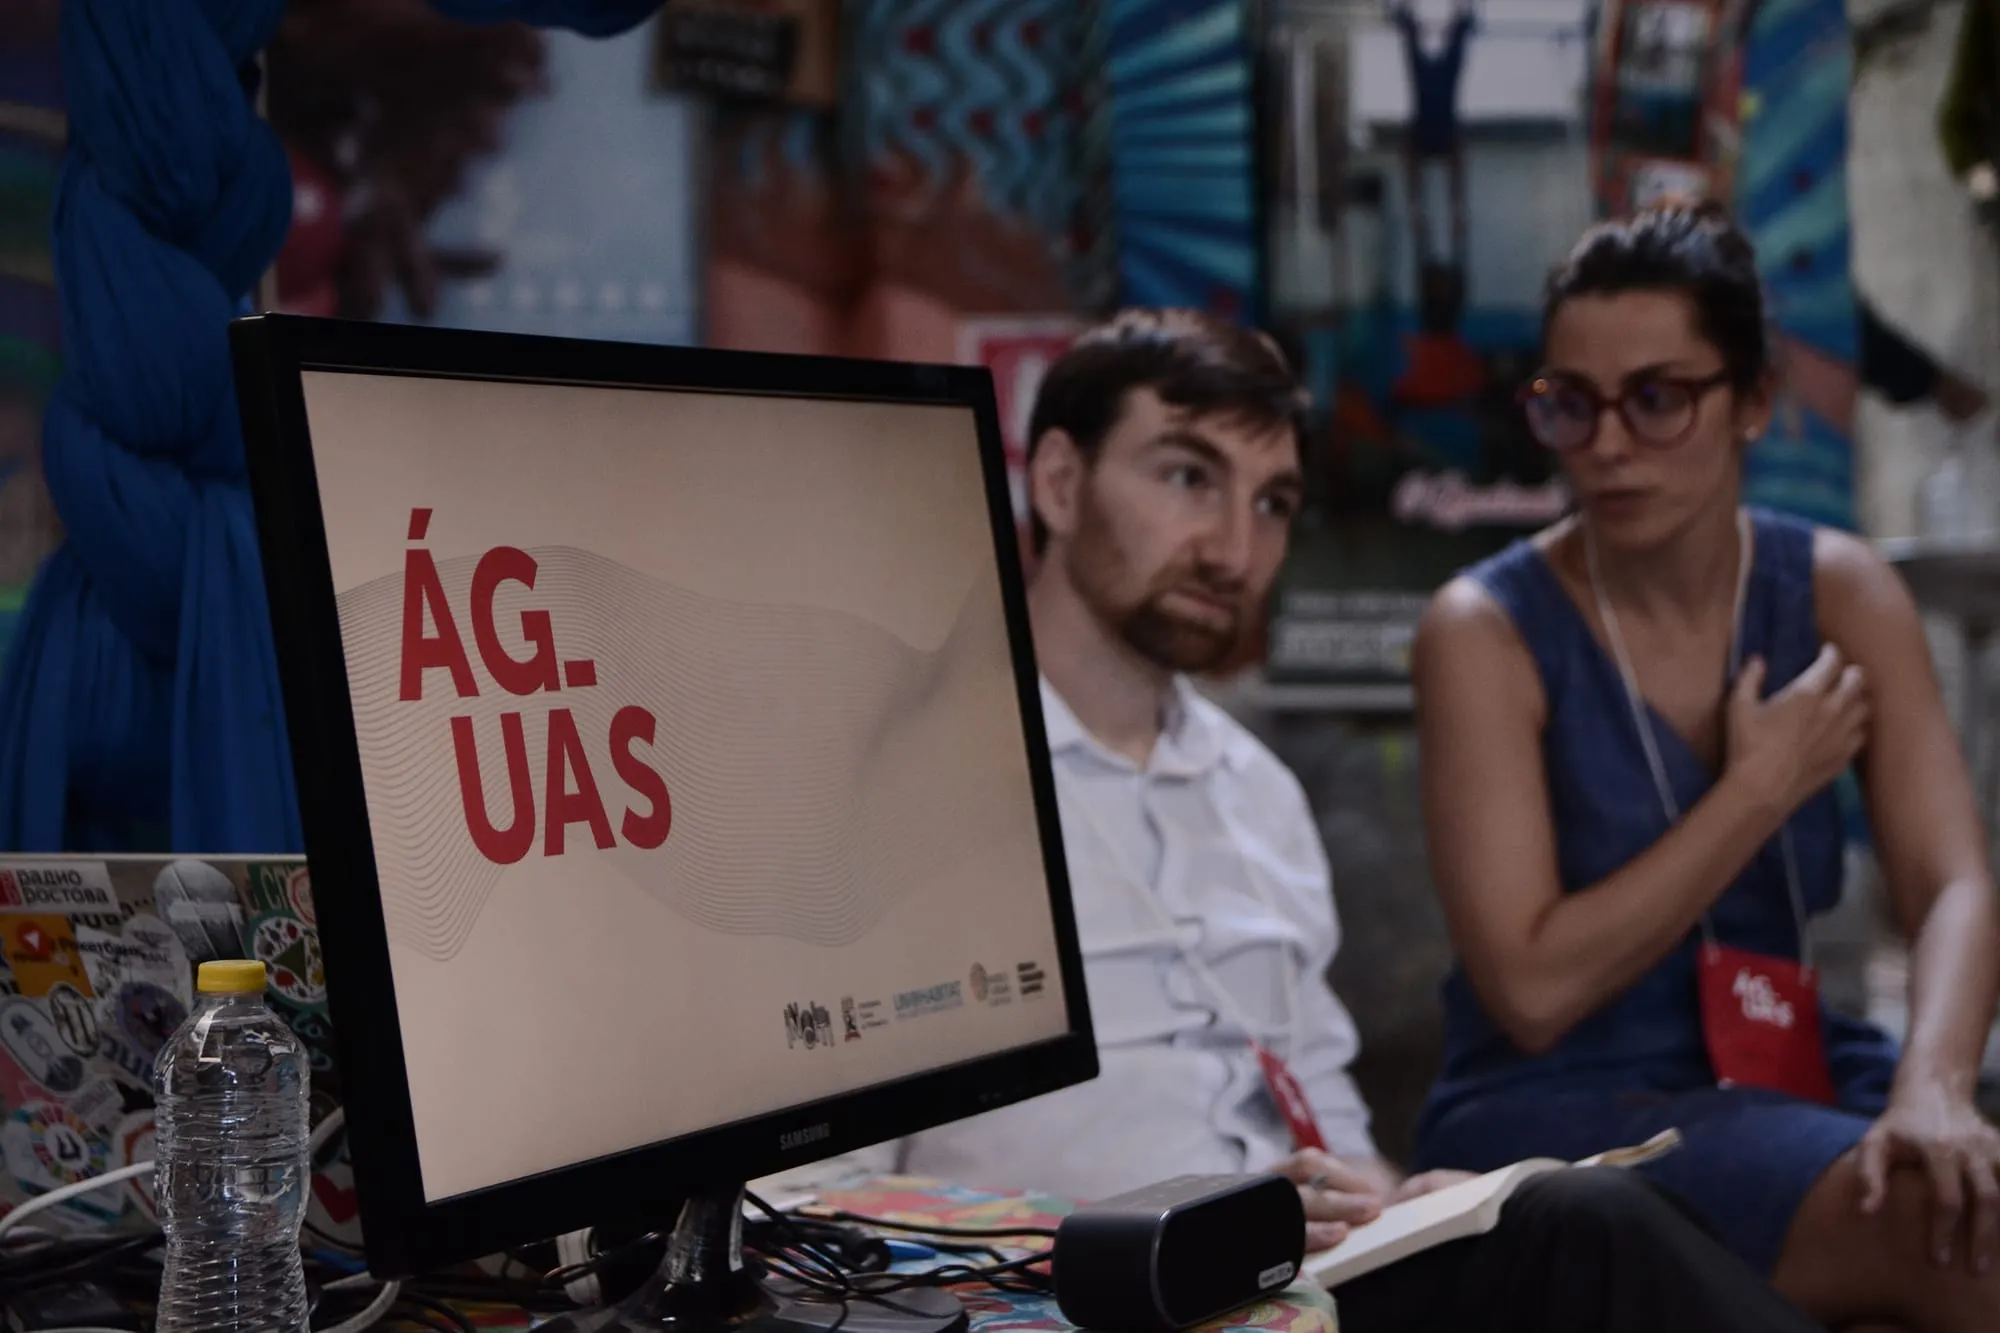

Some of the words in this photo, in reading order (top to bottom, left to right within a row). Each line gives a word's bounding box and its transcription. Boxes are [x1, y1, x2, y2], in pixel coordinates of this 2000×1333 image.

[399, 508, 597, 701] ÁG.
[450, 705, 672, 864] UAS
[779, 1122, 831, 1151] SAMSUNG
